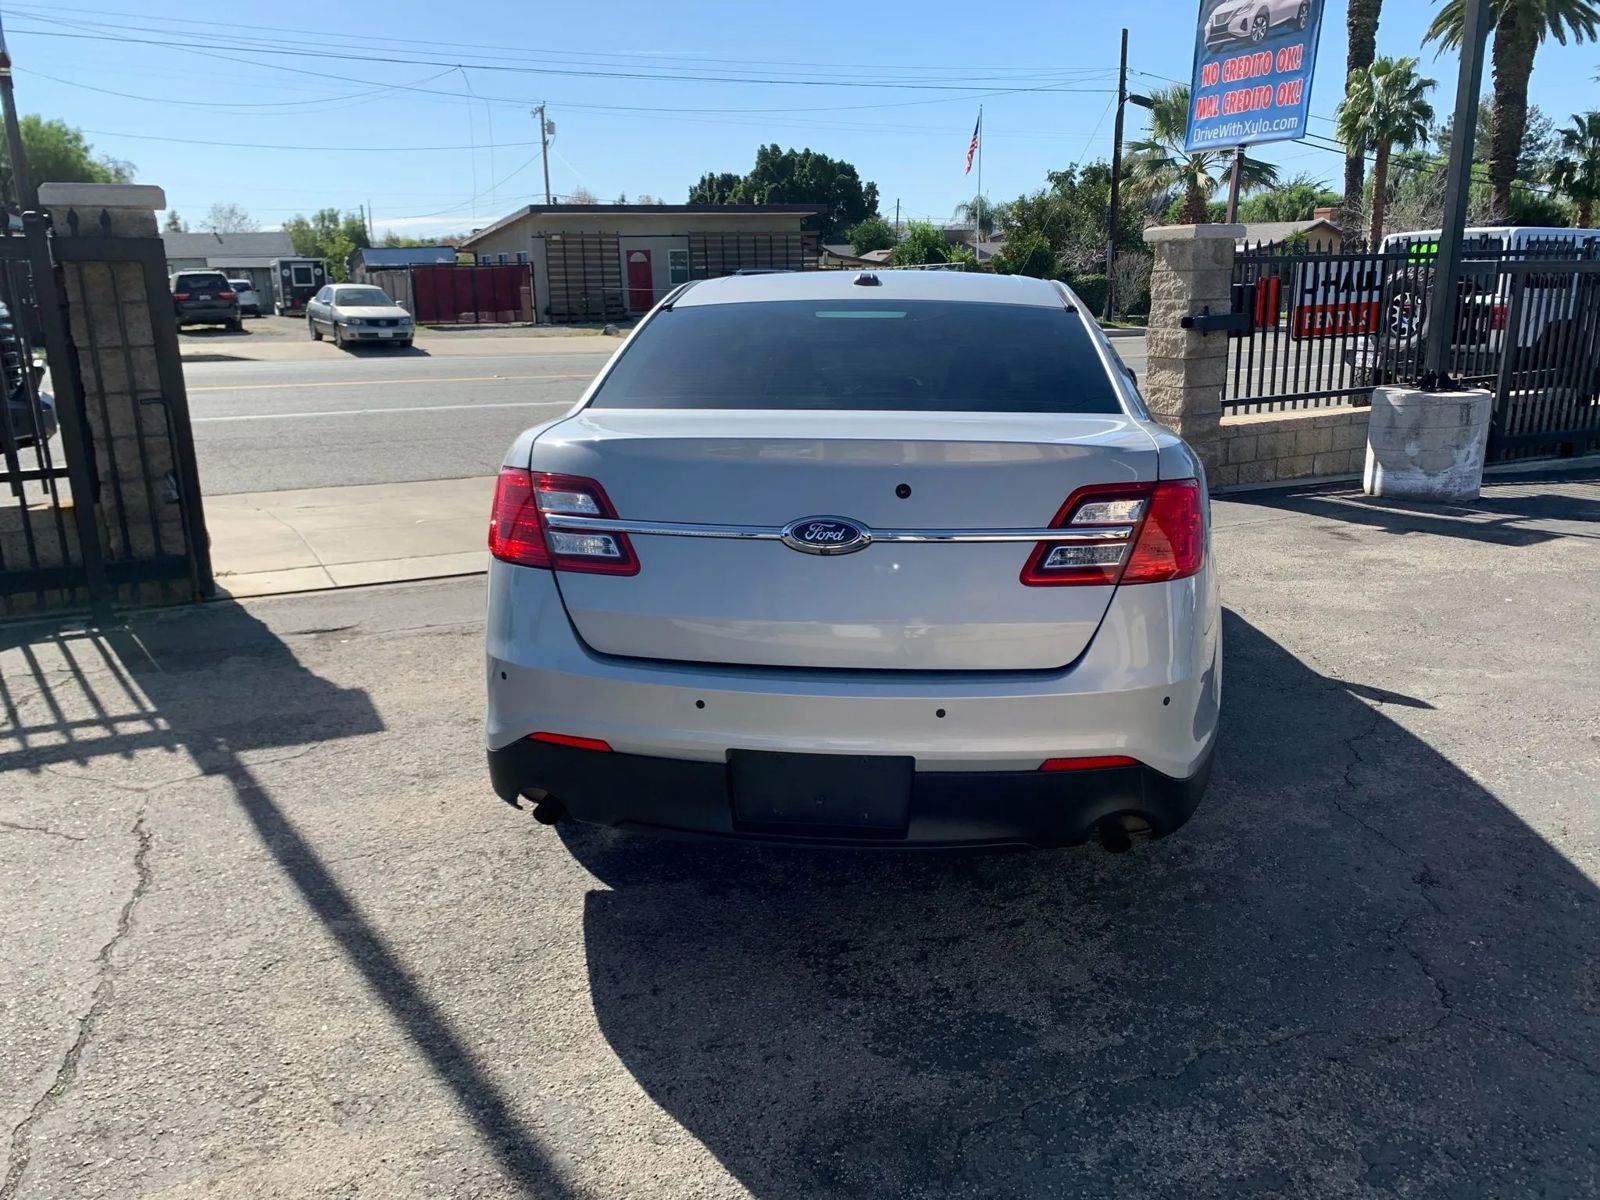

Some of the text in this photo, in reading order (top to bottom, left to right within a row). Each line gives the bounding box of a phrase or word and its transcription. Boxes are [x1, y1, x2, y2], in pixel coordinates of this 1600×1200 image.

[1202, 44, 1303, 87] NO CREDITO OK!
[1195, 79, 1303, 120] MAL CREDITO OK!
[1194, 117, 1298, 142] DriveWithXylo.com
[1304, 310, 1369, 329] RENTAS
[805, 523, 845, 541] Ford
